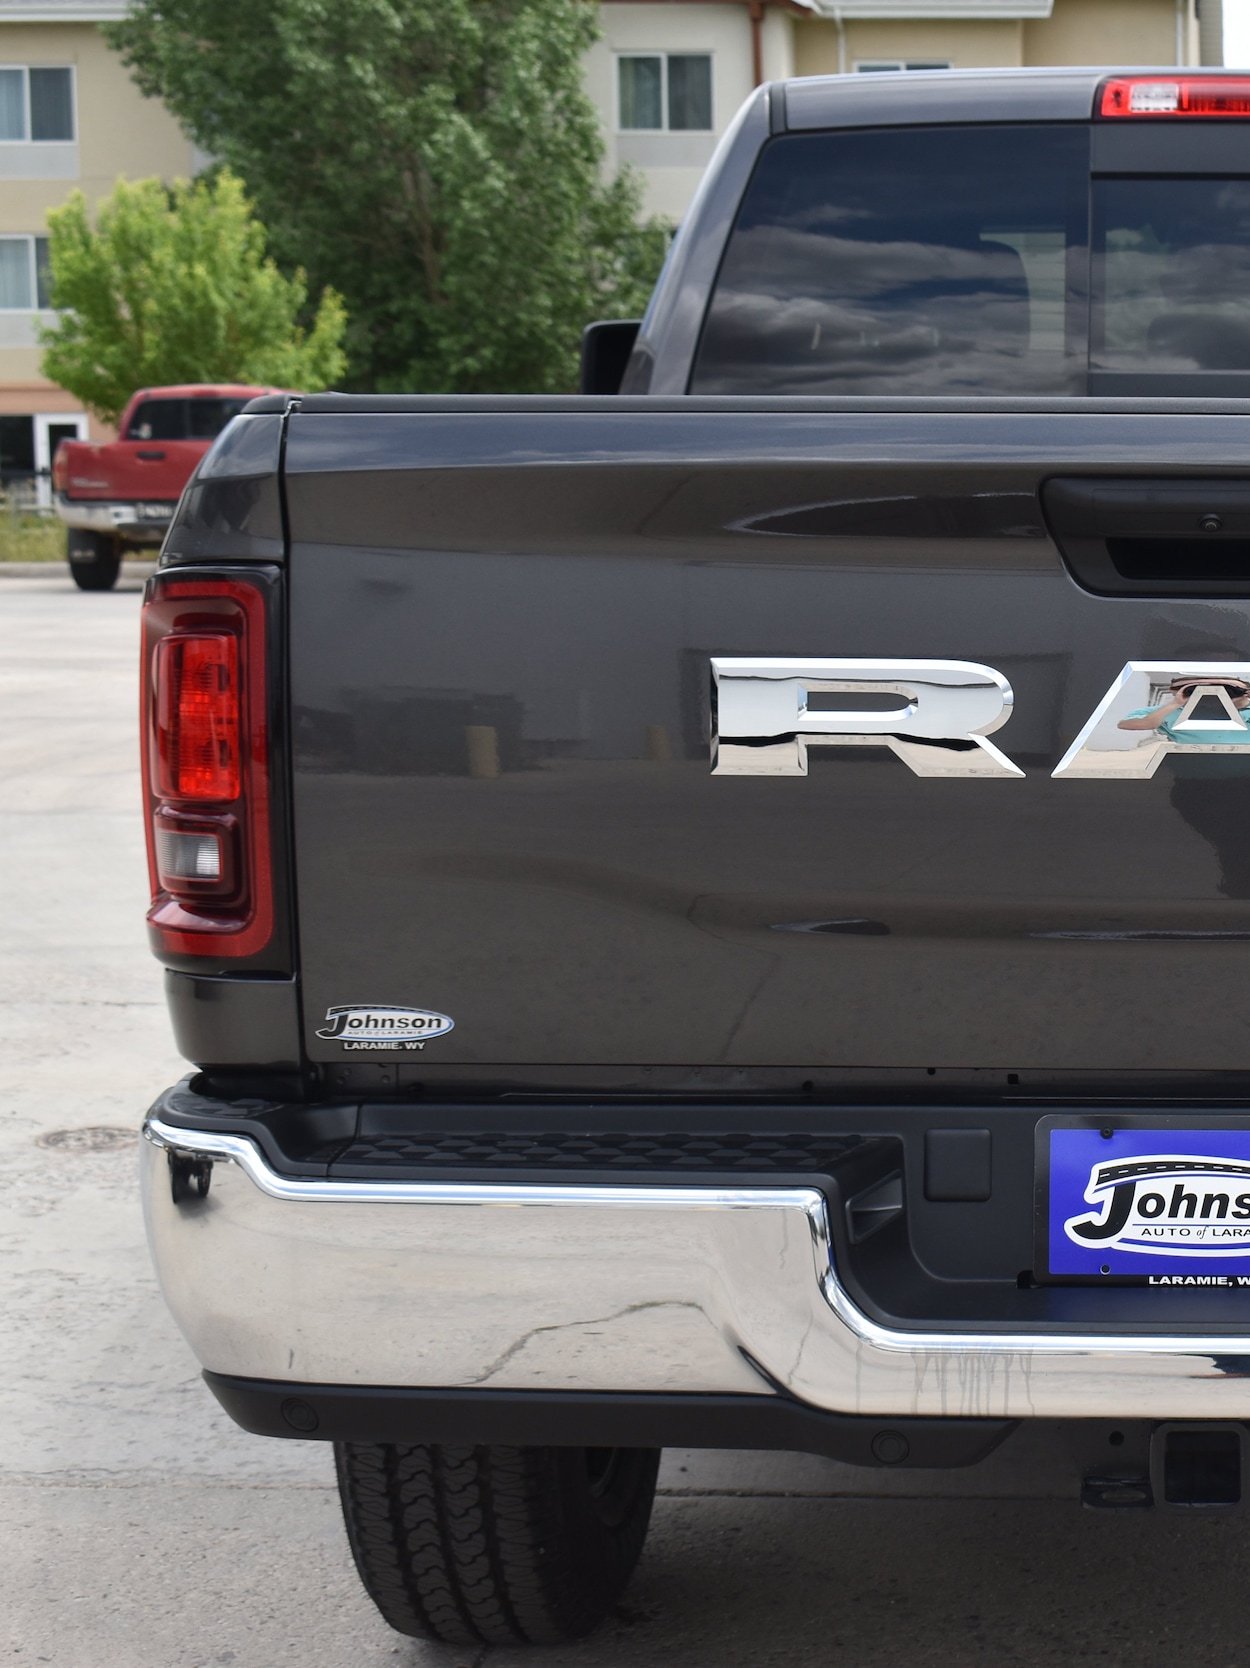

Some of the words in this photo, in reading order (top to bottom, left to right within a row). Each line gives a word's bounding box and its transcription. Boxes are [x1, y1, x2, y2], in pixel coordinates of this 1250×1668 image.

[317, 1012, 442, 1037] Johnson
[404, 1041, 426, 1050] WY
[1140, 1227, 1191, 1238] AUTO
[1195, 1224, 1210, 1240] of
[1148, 1275, 1234, 1288] LARAMIE,
